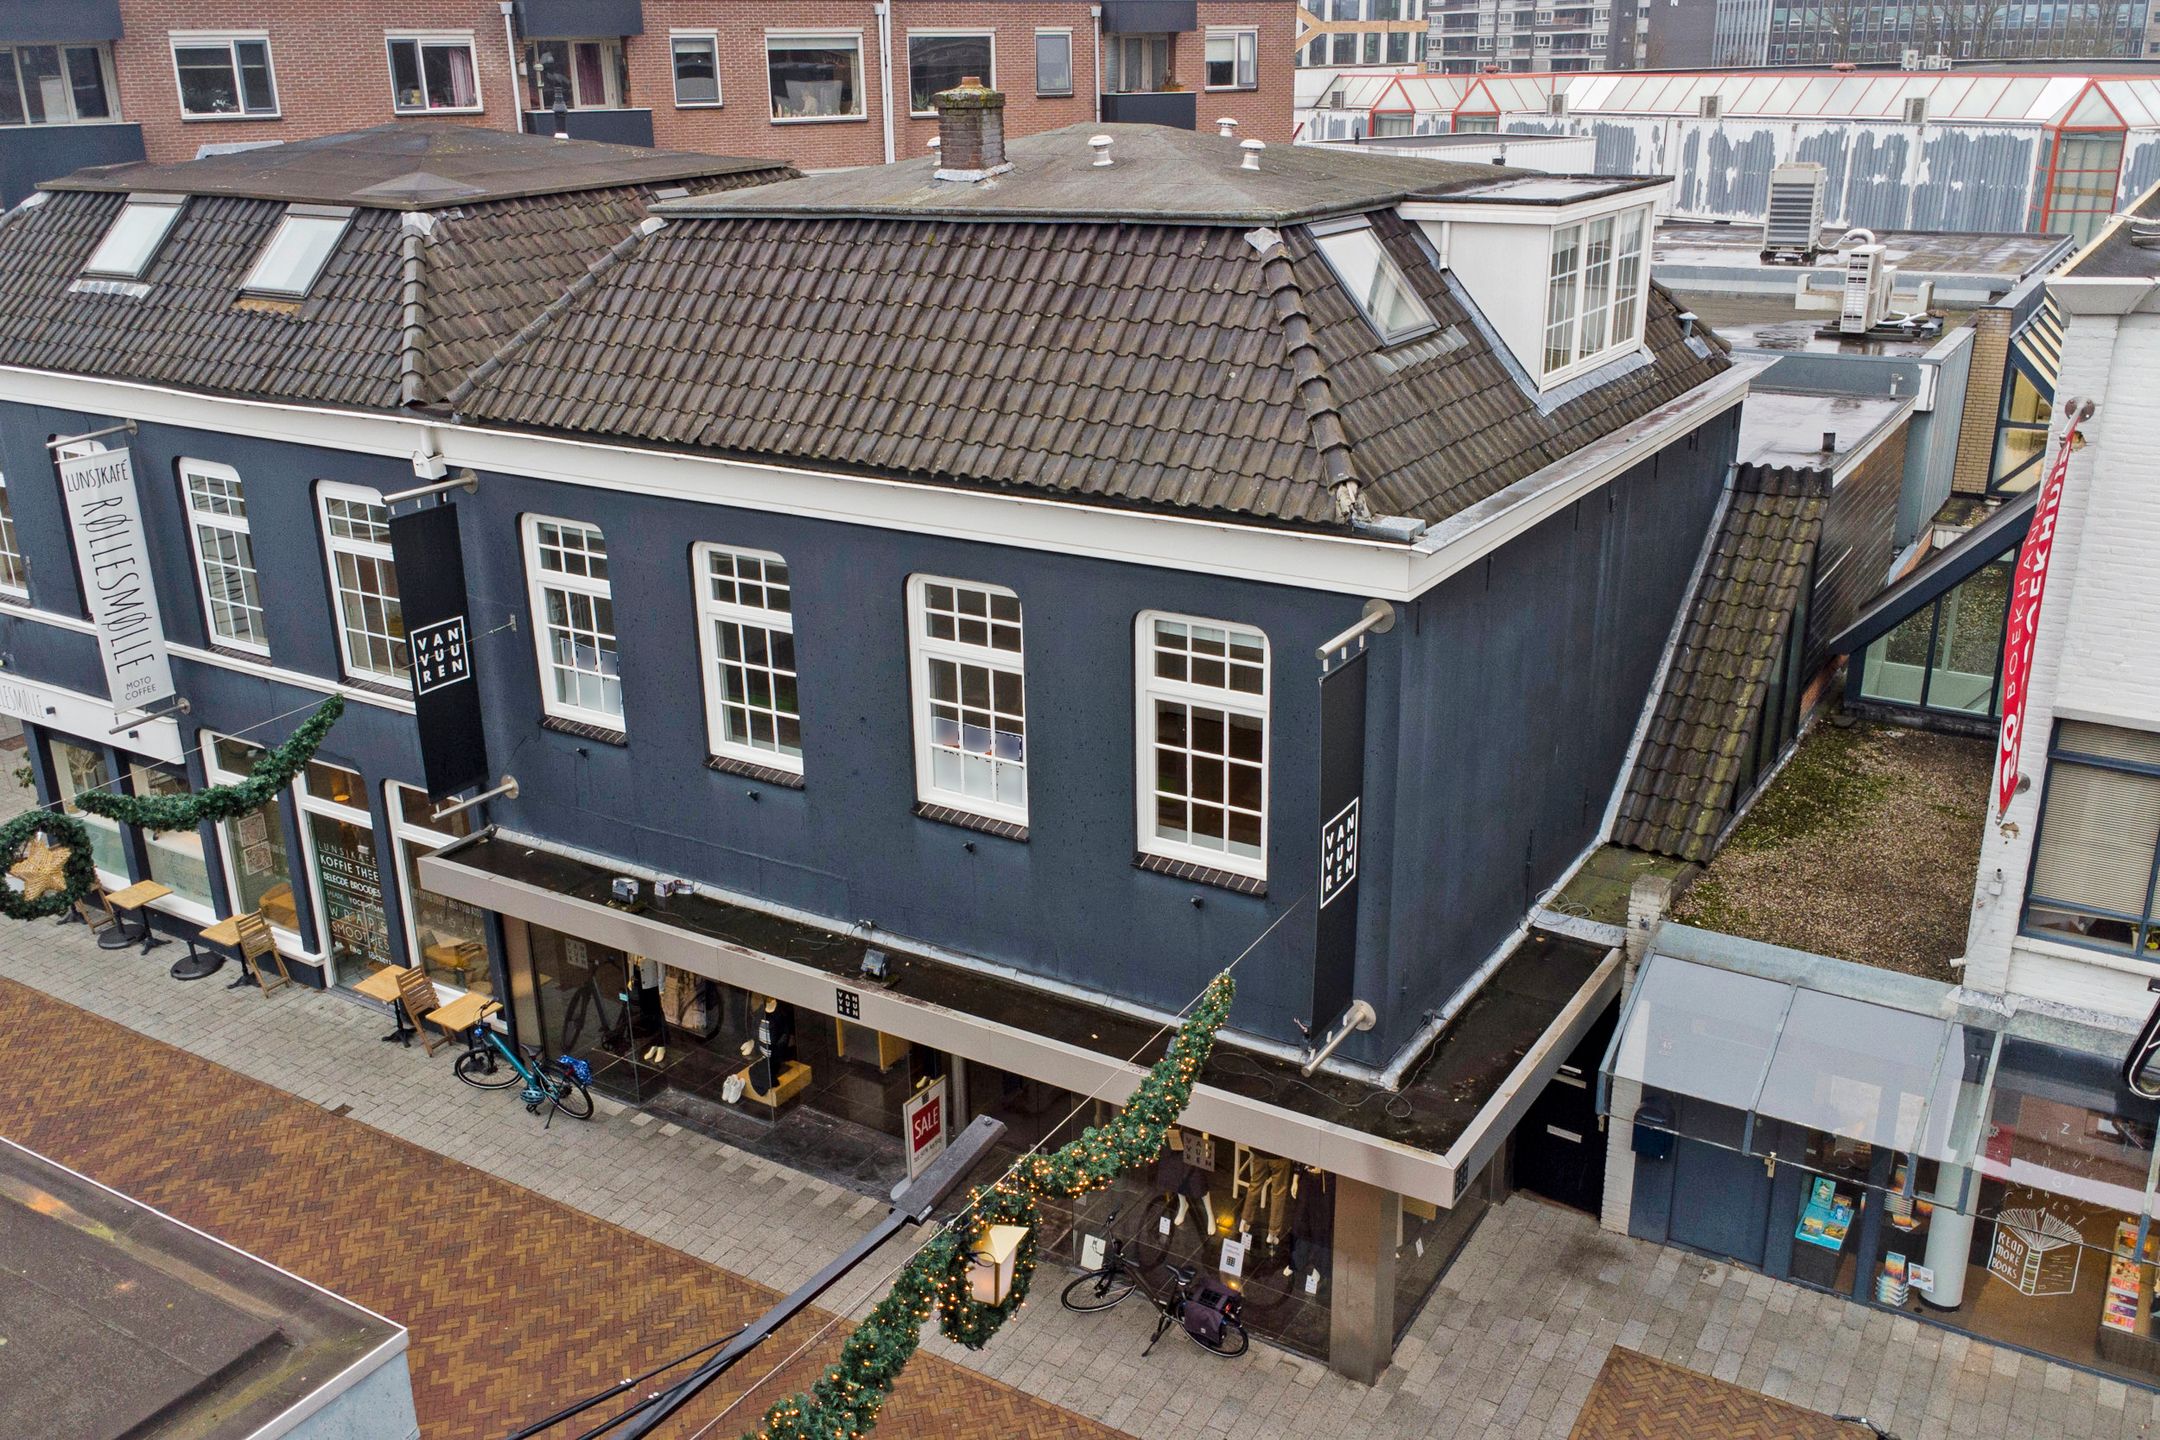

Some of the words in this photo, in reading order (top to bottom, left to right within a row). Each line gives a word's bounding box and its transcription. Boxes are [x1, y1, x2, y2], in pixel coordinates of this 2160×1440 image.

[65, 458, 129, 493] LUNSJKAFÉ
[79, 496, 155, 675] RØLLESMØLLE
[417, 627, 460, 651] VAN
[420, 643, 461, 667] VUU
[126, 675, 152, 691] MOTO
[422, 658, 464, 684] REN
[124, 683, 157, 701] COFFEE
[1326, 814, 1355, 849] VAN
[1325, 833, 1354, 871] VUU
[319, 854, 353, 874] KOFFIE
[355, 864, 380, 882] THEE
[1325, 854, 1353, 893] REN
[837, 991, 858, 1003] VAN
[838, 998, 858, 1010] VUU
[838, 1005, 859, 1017] REN
[914, 1106, 939, 1140] SALE
[1997, 1231, 2024, 1256] READ
[1991, 1257, 2018, 1280] BOOKS
